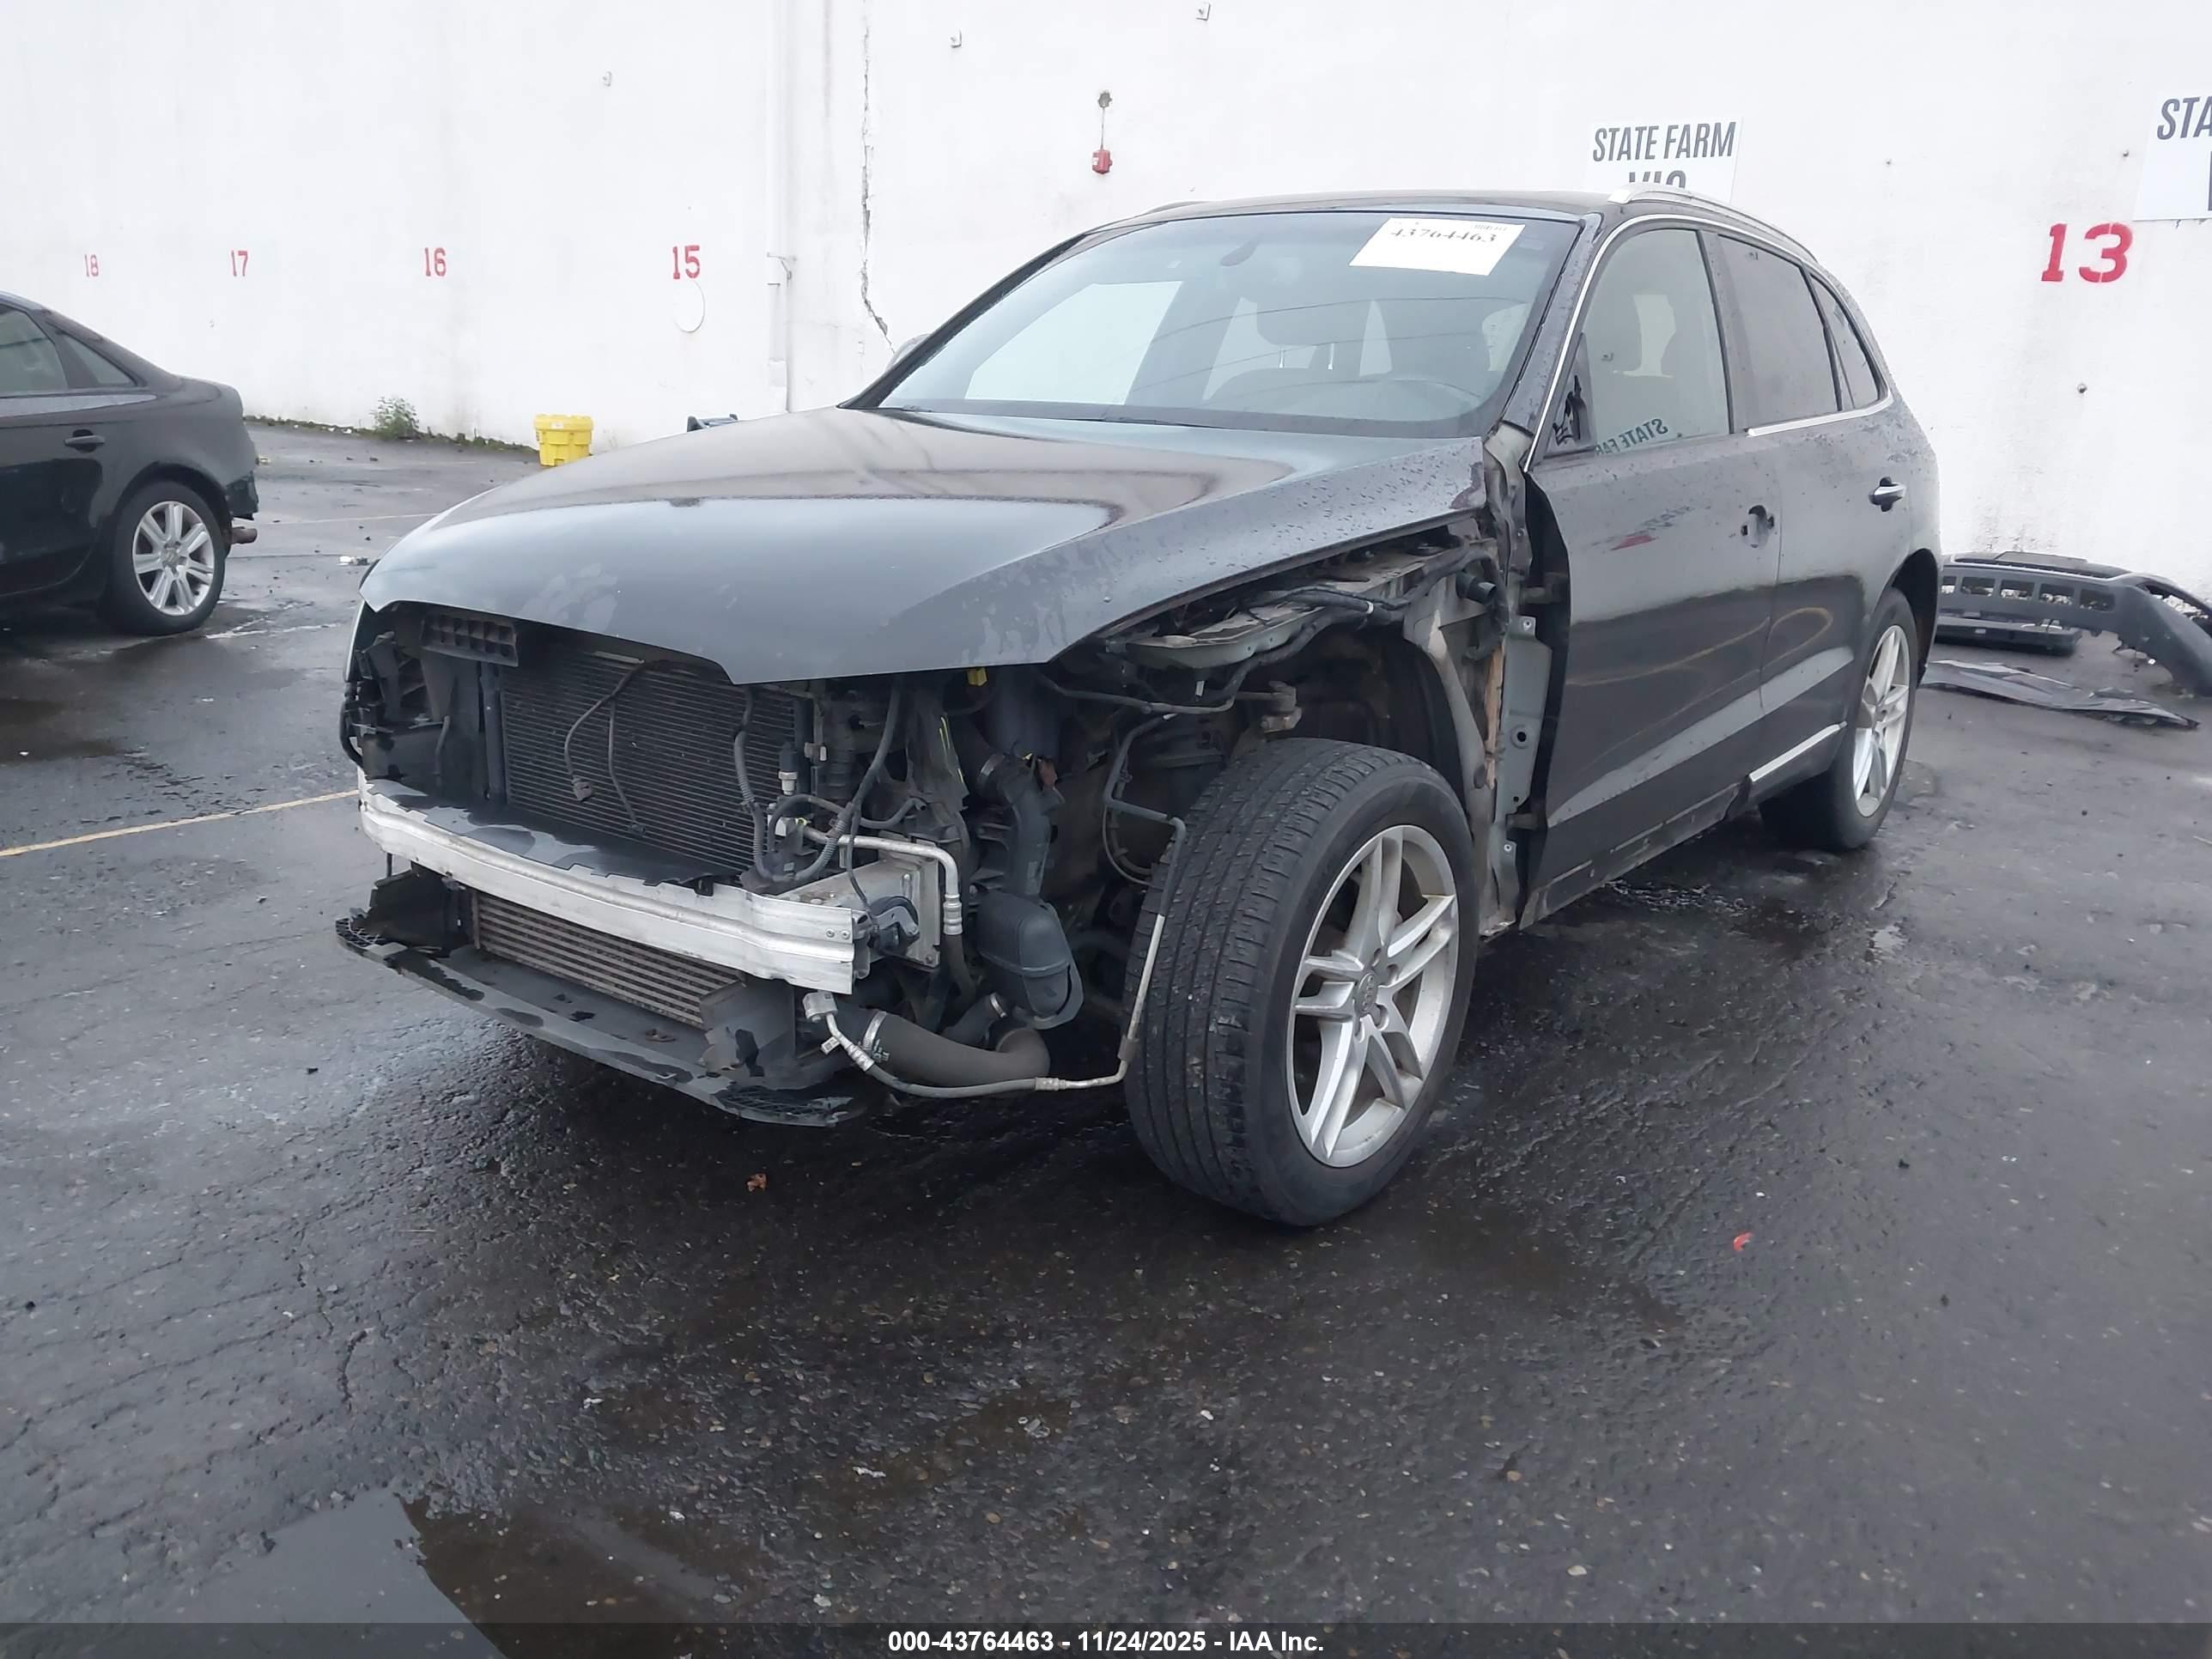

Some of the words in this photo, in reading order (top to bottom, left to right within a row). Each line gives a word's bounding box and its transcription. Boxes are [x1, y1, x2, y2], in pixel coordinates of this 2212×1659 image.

[1593, 125, 1659, 161] STATE
[1663, 121, 1736, 159] FARM
[84, 254, 100, 277] 18
[231, 250, 249, 277] 17
[424, 247, 447, 276] 16
[672, 245, 701, 280] 15
[2040, 222, 2134, 283] 13
